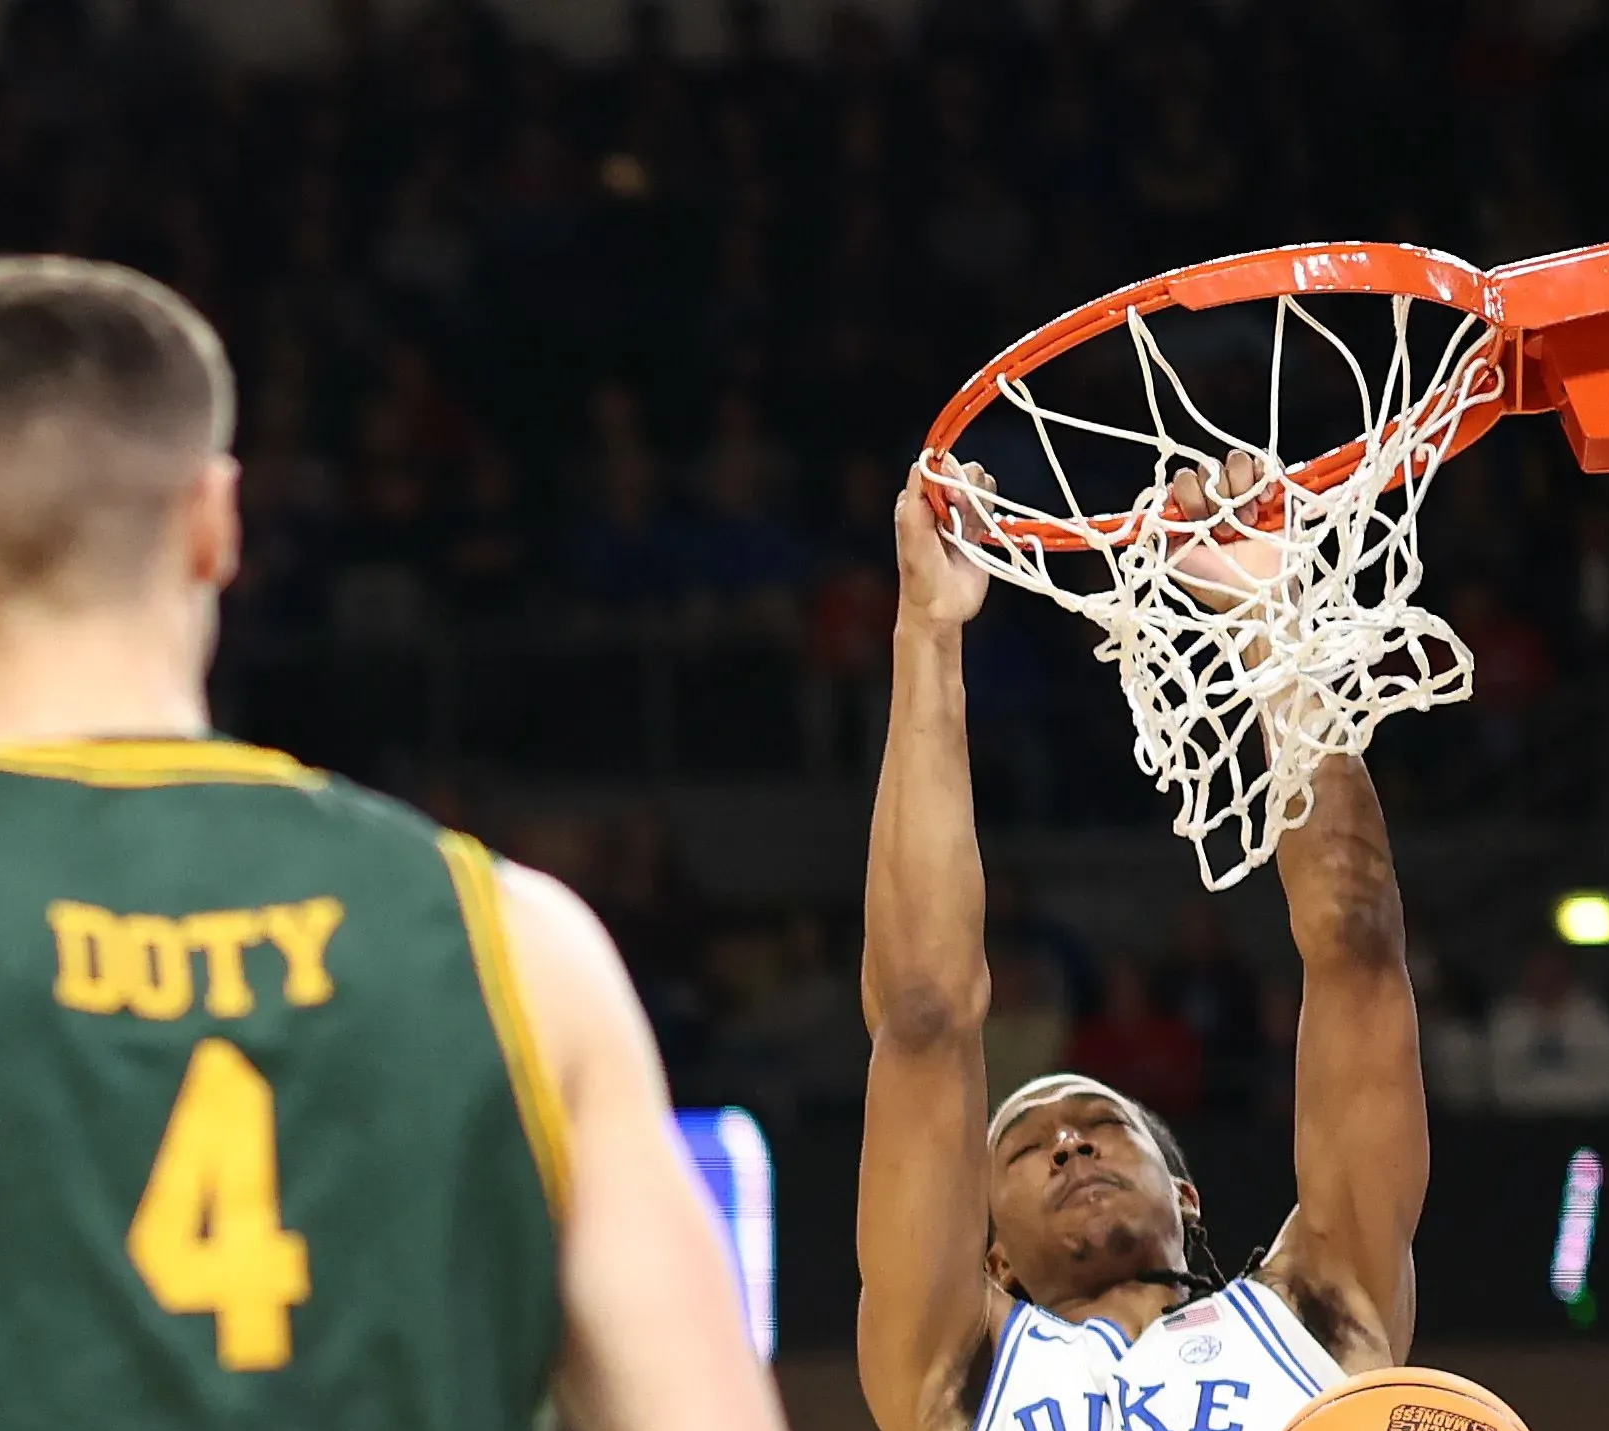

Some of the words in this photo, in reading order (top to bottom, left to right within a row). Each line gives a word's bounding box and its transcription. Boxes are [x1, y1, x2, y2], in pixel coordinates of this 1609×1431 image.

[47, 896, 344, 1020] DOTY
[127, 1037, 310, 1371] 4
[1392, 1405, 1472, 1431] MADNESS
